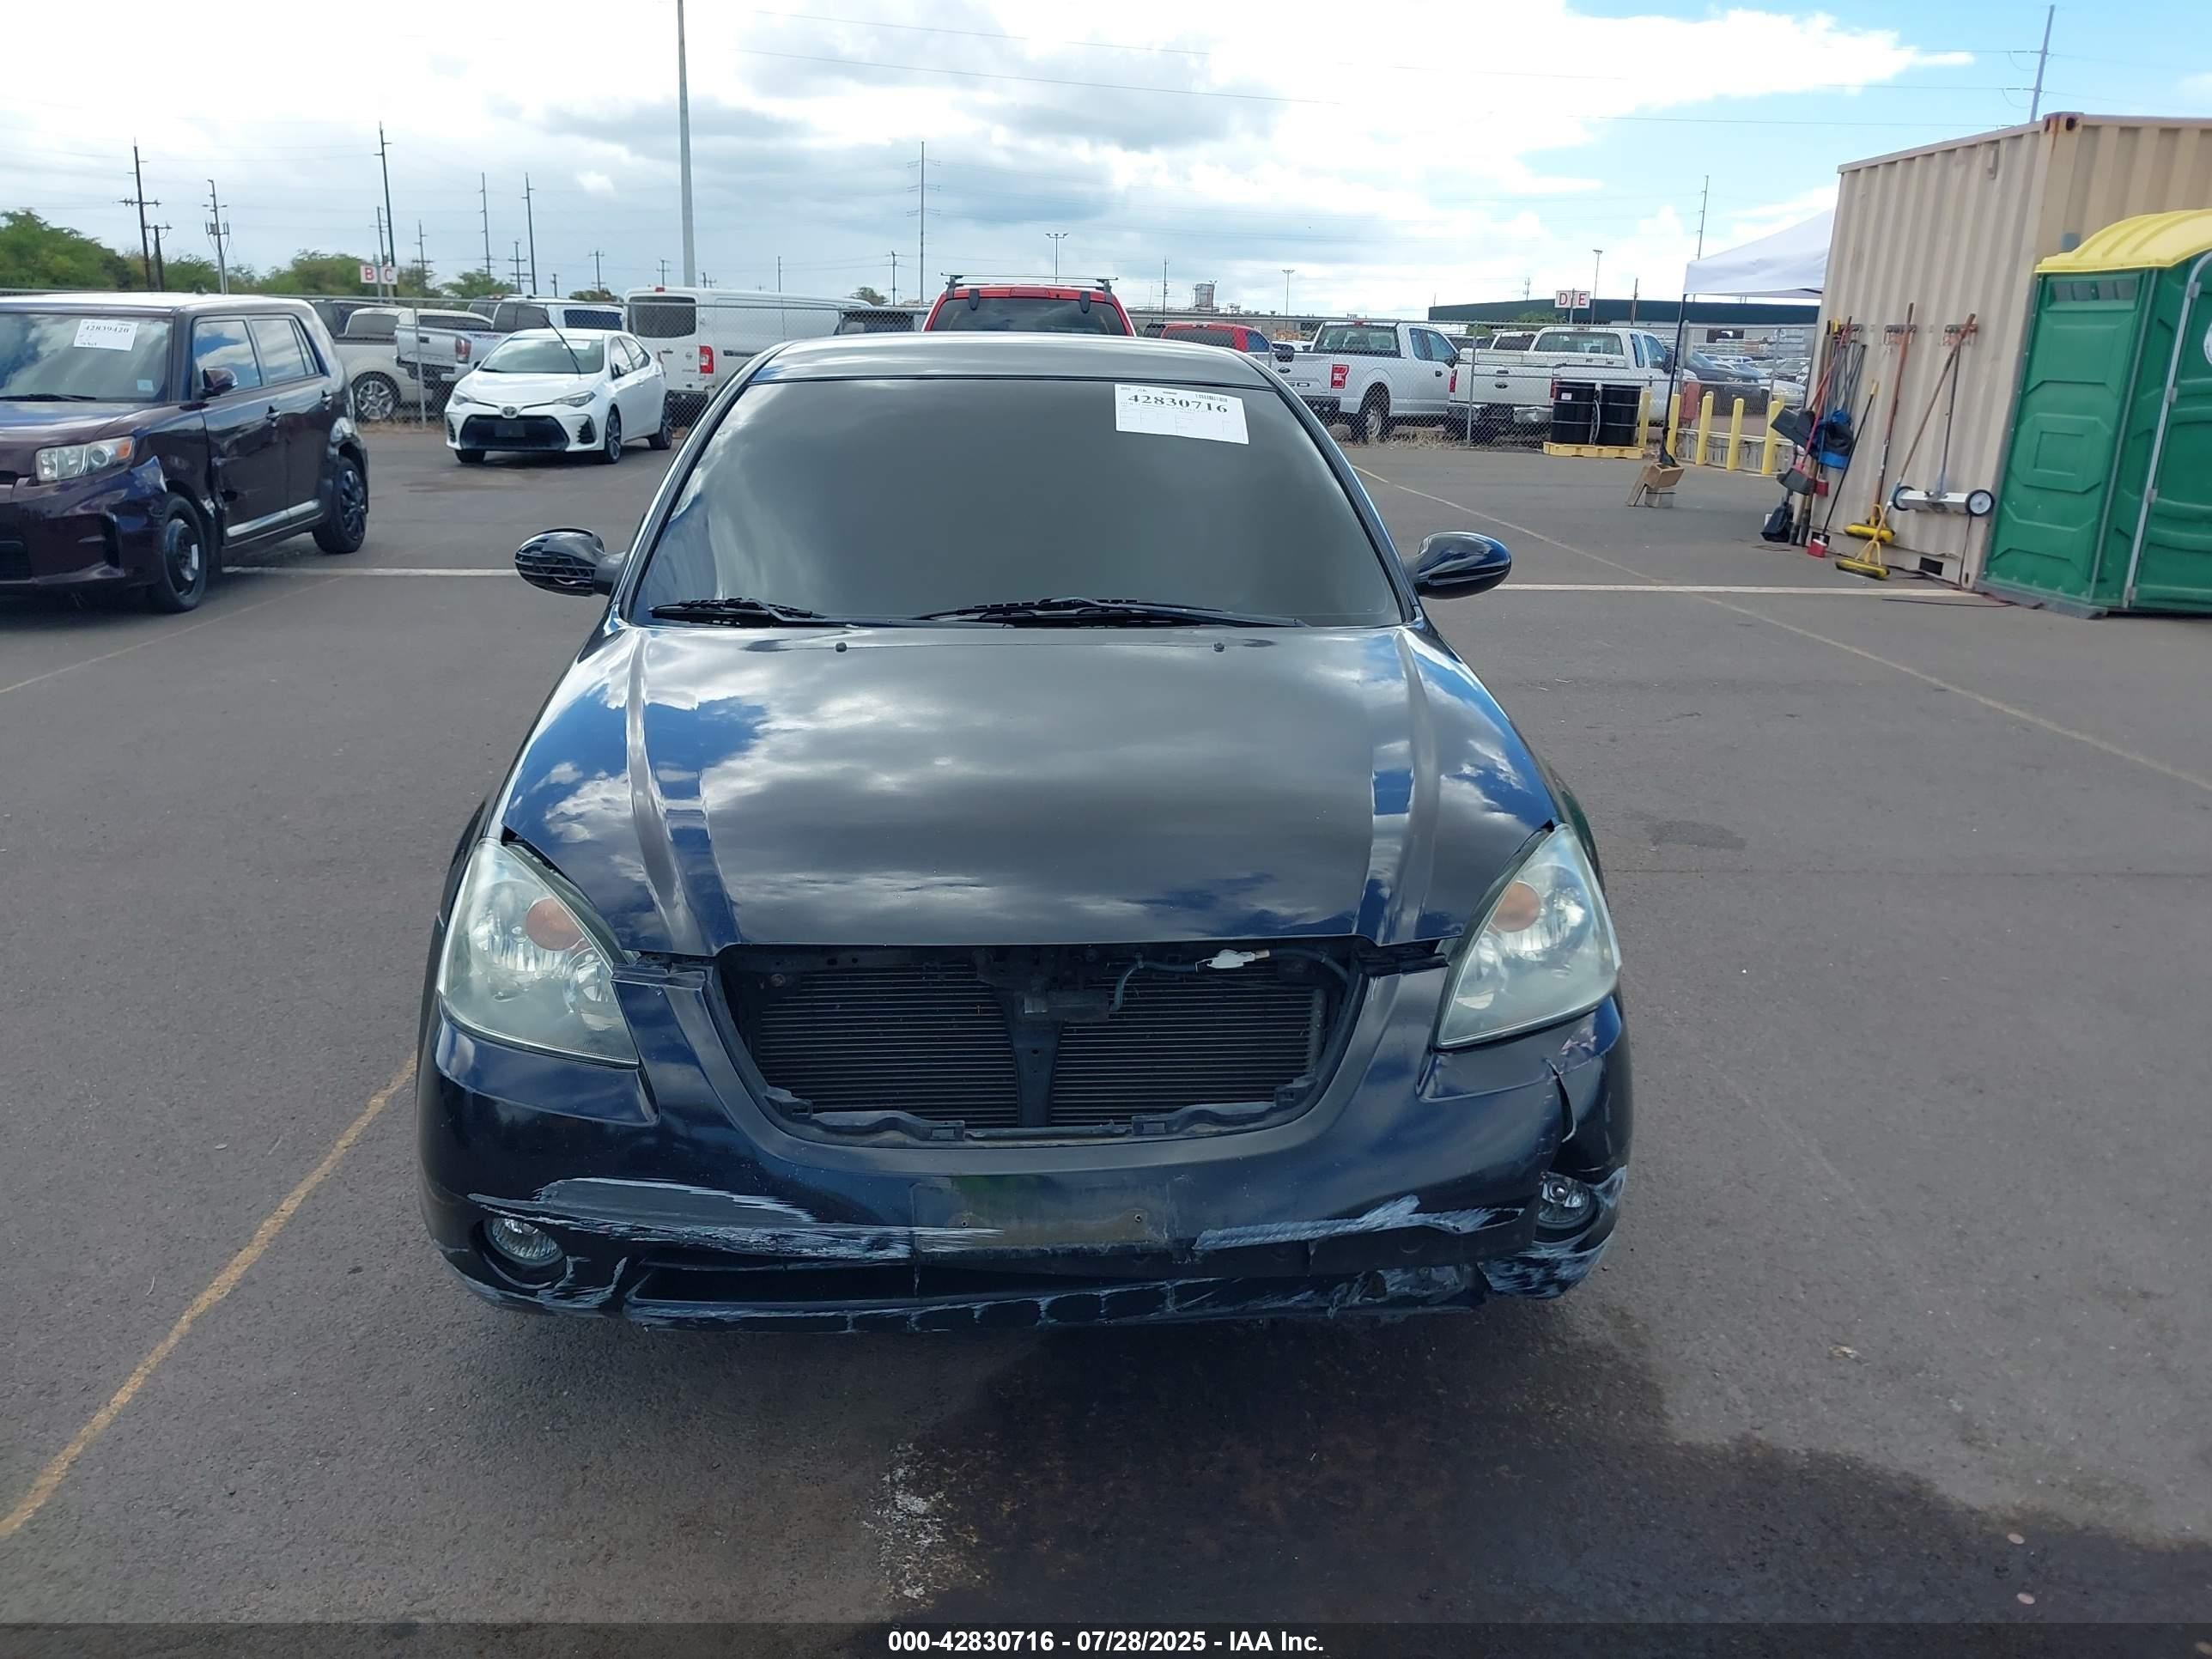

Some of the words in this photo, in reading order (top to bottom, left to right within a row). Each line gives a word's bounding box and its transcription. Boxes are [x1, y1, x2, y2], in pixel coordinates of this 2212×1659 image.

[364, 267, 374, 281] B
[384, 268, 394, 282] C
[1559, 292, 1568, 306] D
[1578, 293, 1587, 306] E
[1127, 394, 1228, 413] 42830716
